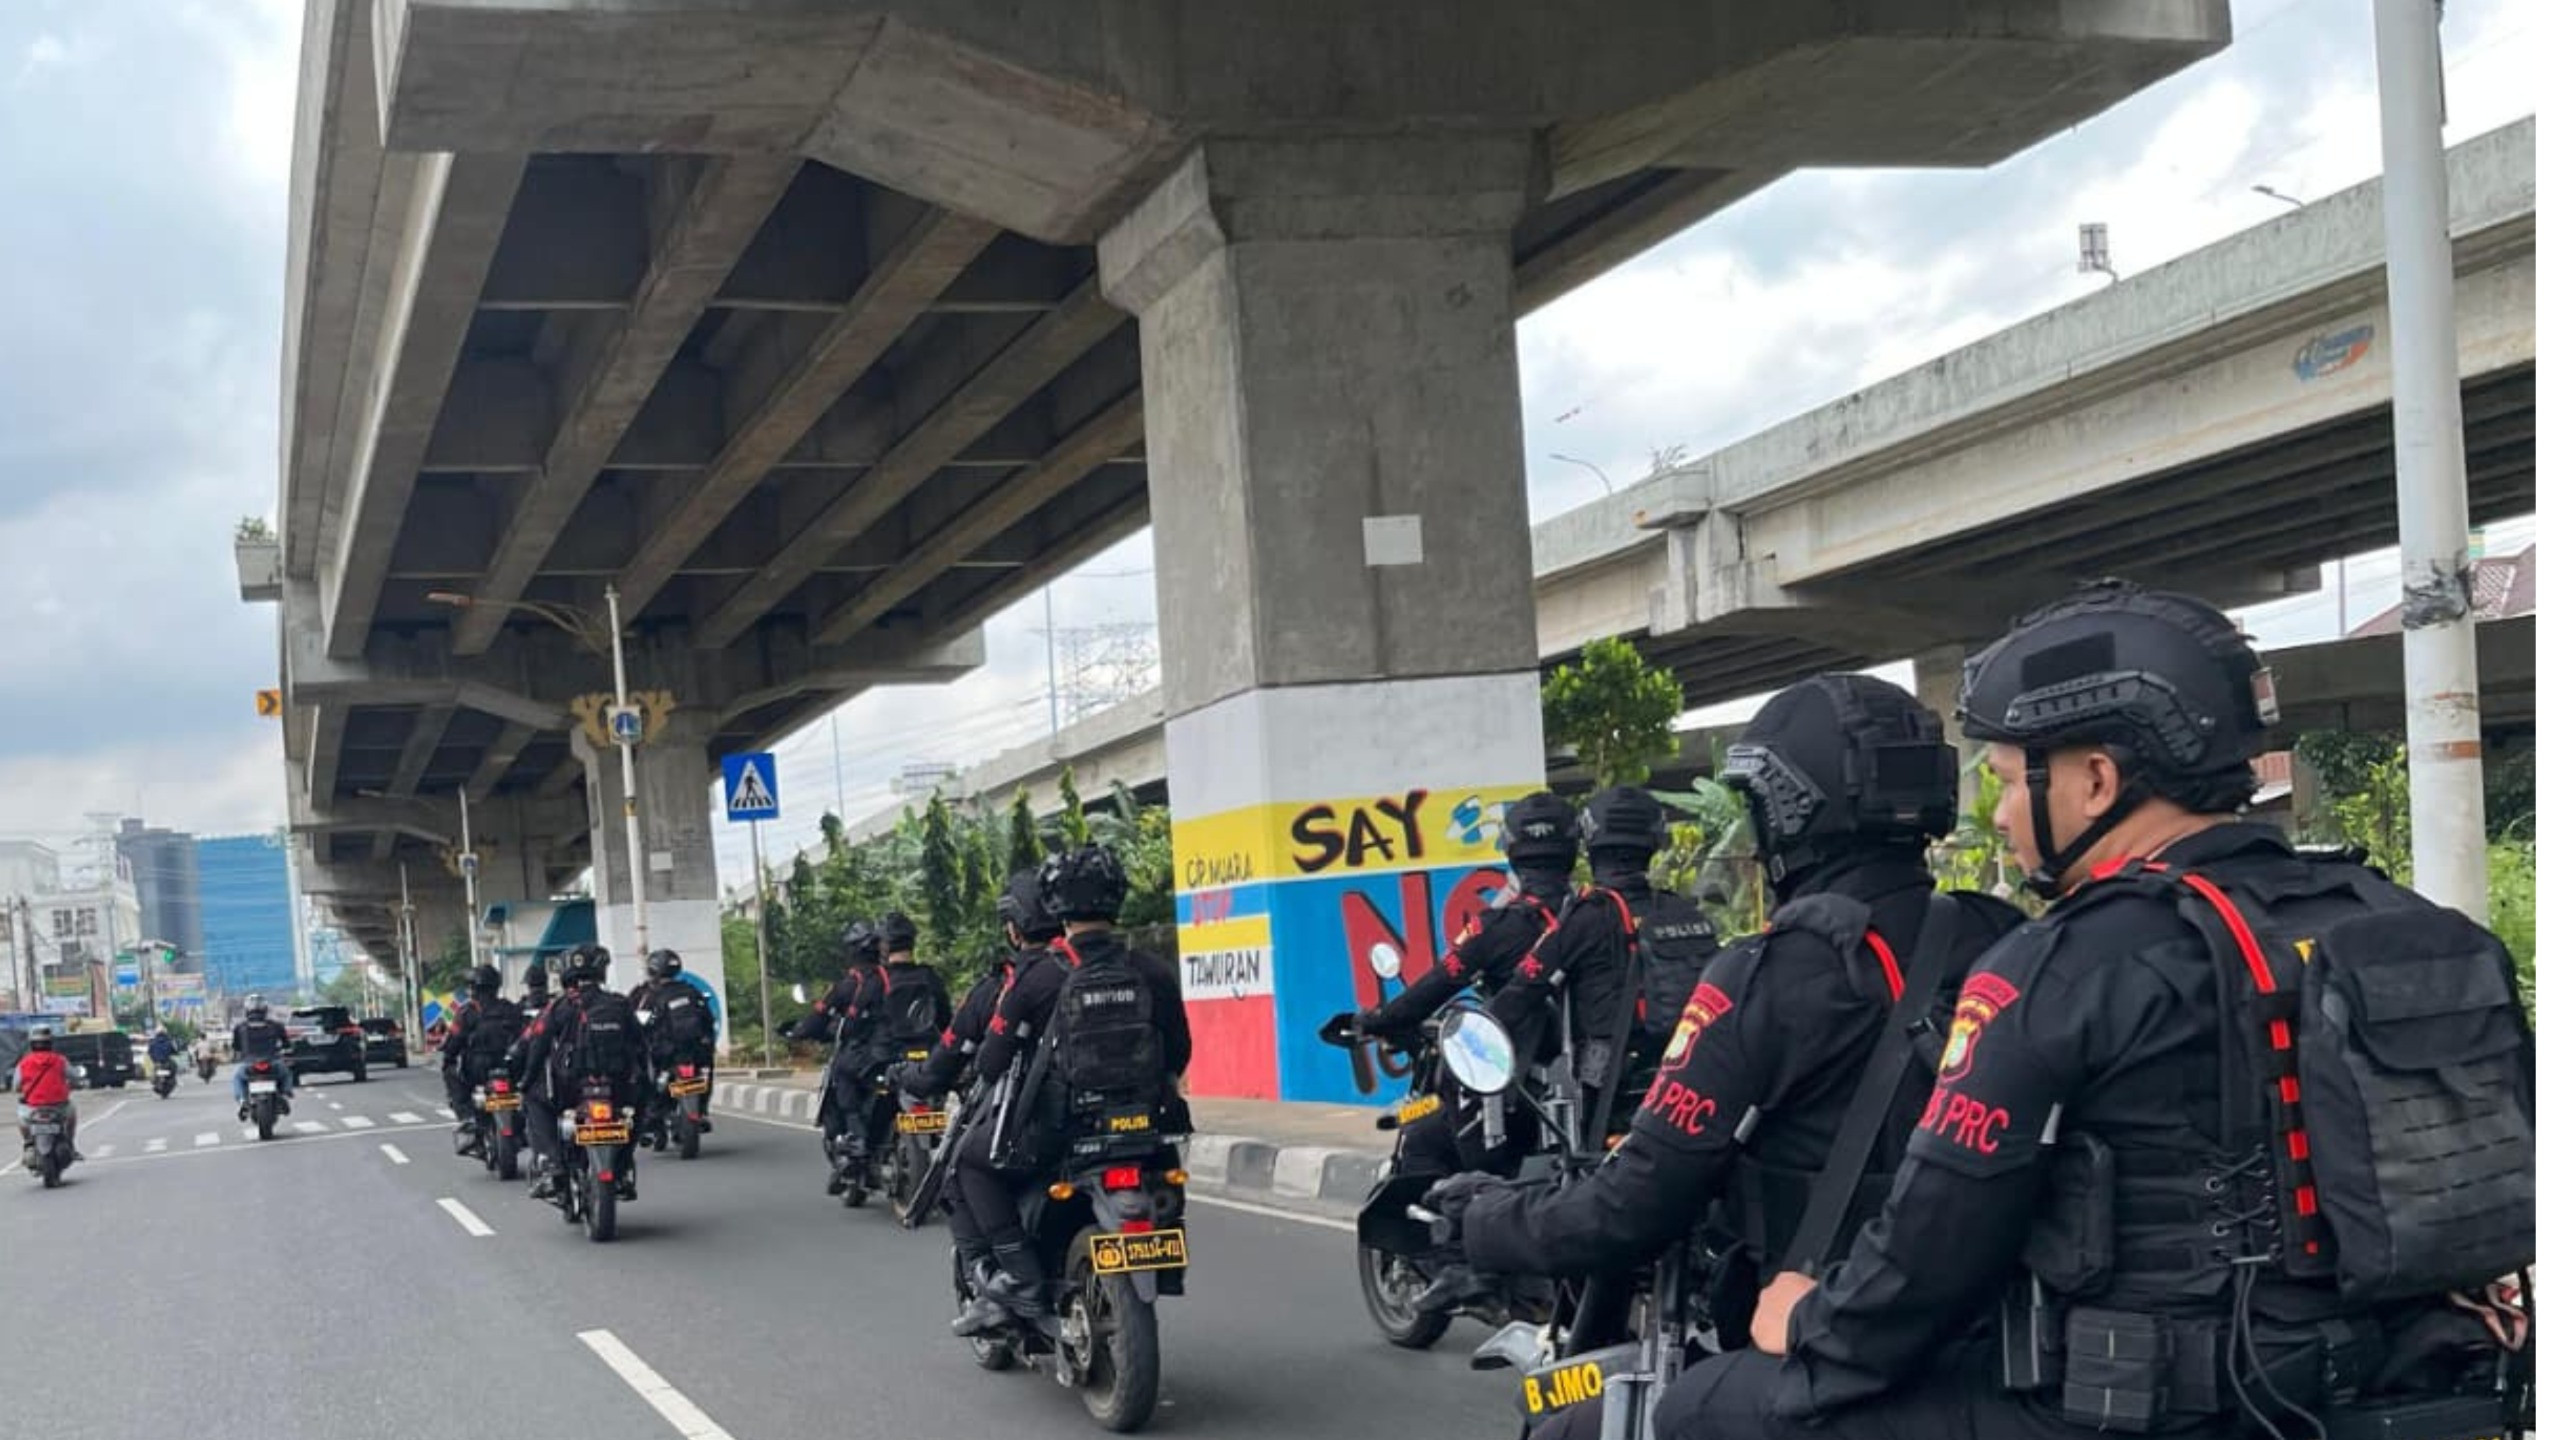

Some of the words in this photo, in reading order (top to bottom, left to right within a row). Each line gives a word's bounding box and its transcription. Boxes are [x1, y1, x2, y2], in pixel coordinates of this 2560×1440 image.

[1291, 789, 1428, 873] SAY
[1653, 1081, 1716, 1135] PRC
[1936, 1093, 2010, 1154] PRC
